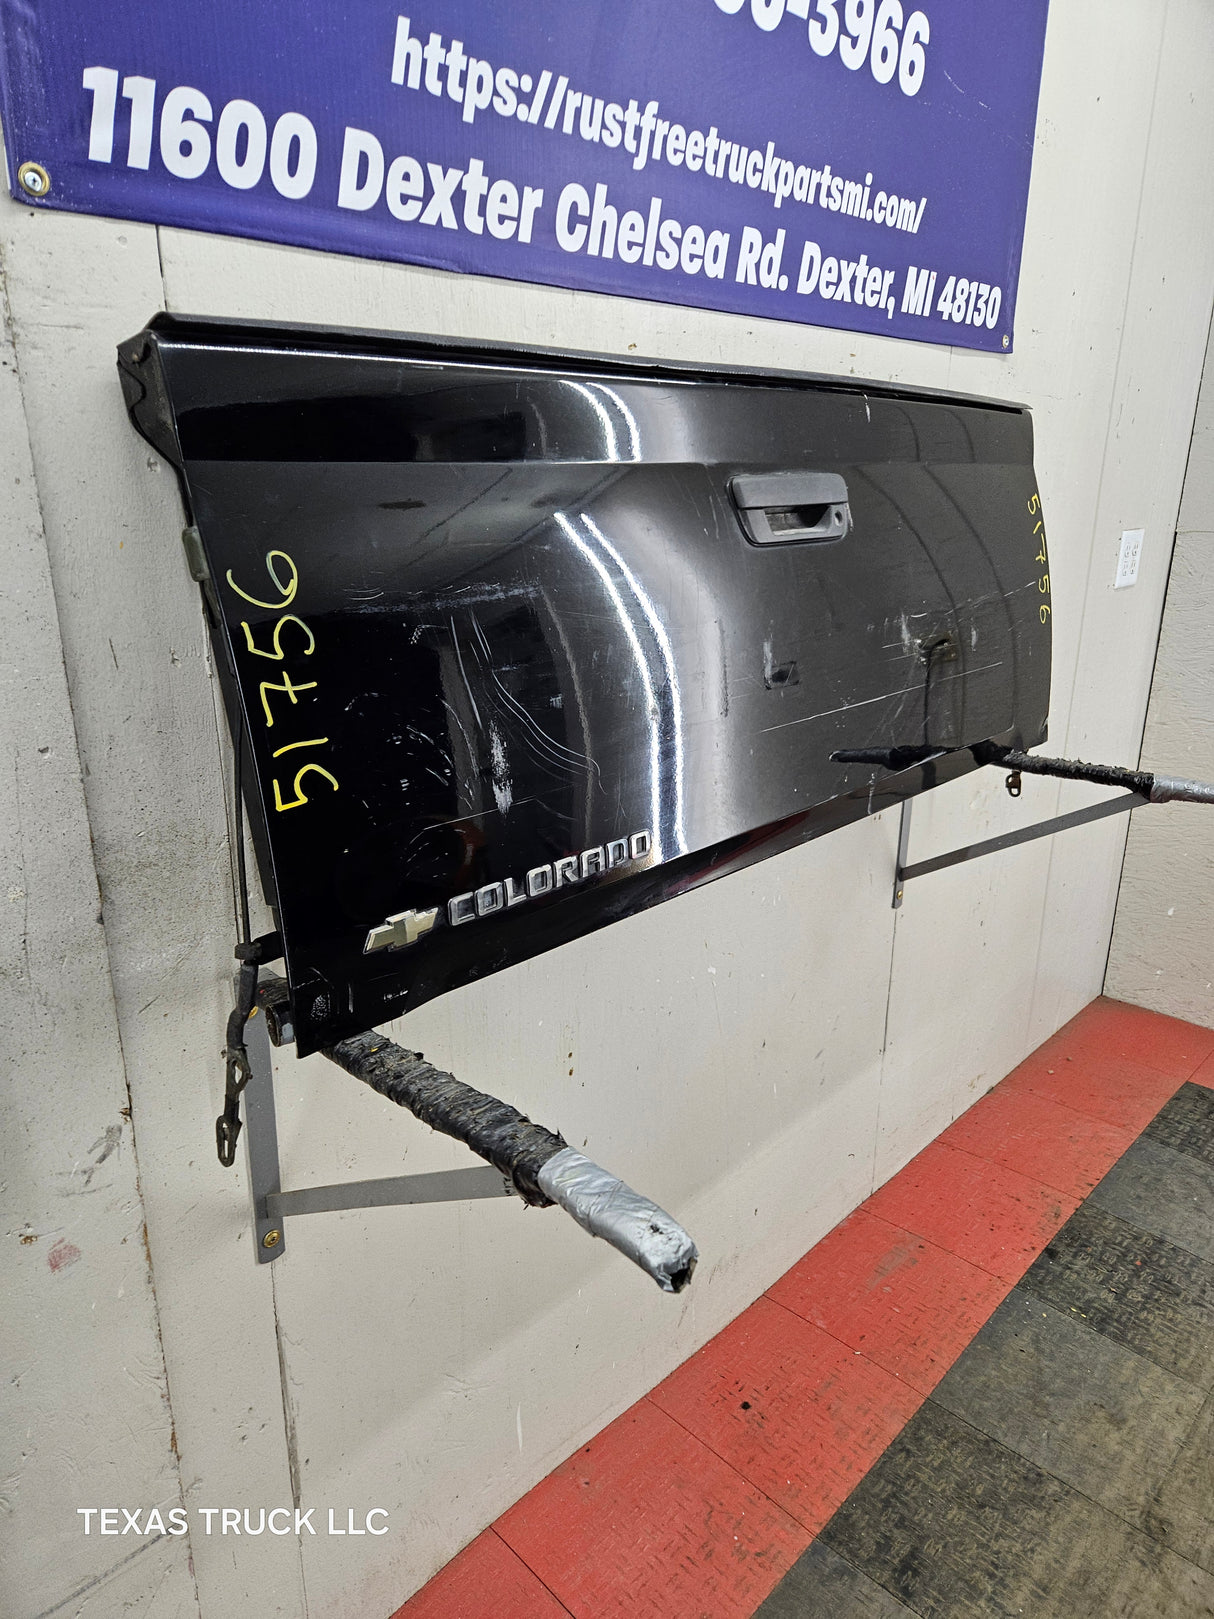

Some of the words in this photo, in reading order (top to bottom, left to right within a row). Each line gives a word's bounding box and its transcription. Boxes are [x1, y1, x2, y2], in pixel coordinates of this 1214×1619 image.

[82, 66, 318, 200] 11600
[337, 126, 543, 244] Dexter
[554, 182, 730, 280] Chelsea
[736, 227, 790, 292] Rd.
[797, 241, 896, 319] Dexter,
[901, 265, 937, 317] MI
[937, 274, 1003, 330] 48130
[390, 15, 927, 234] https://rustfreetruckpartsmi.com/
[1028, 493, 1051, 624] 51756
[226, 550, 339, 812] 51756
[447, 829, 651, 927] COLORADO
